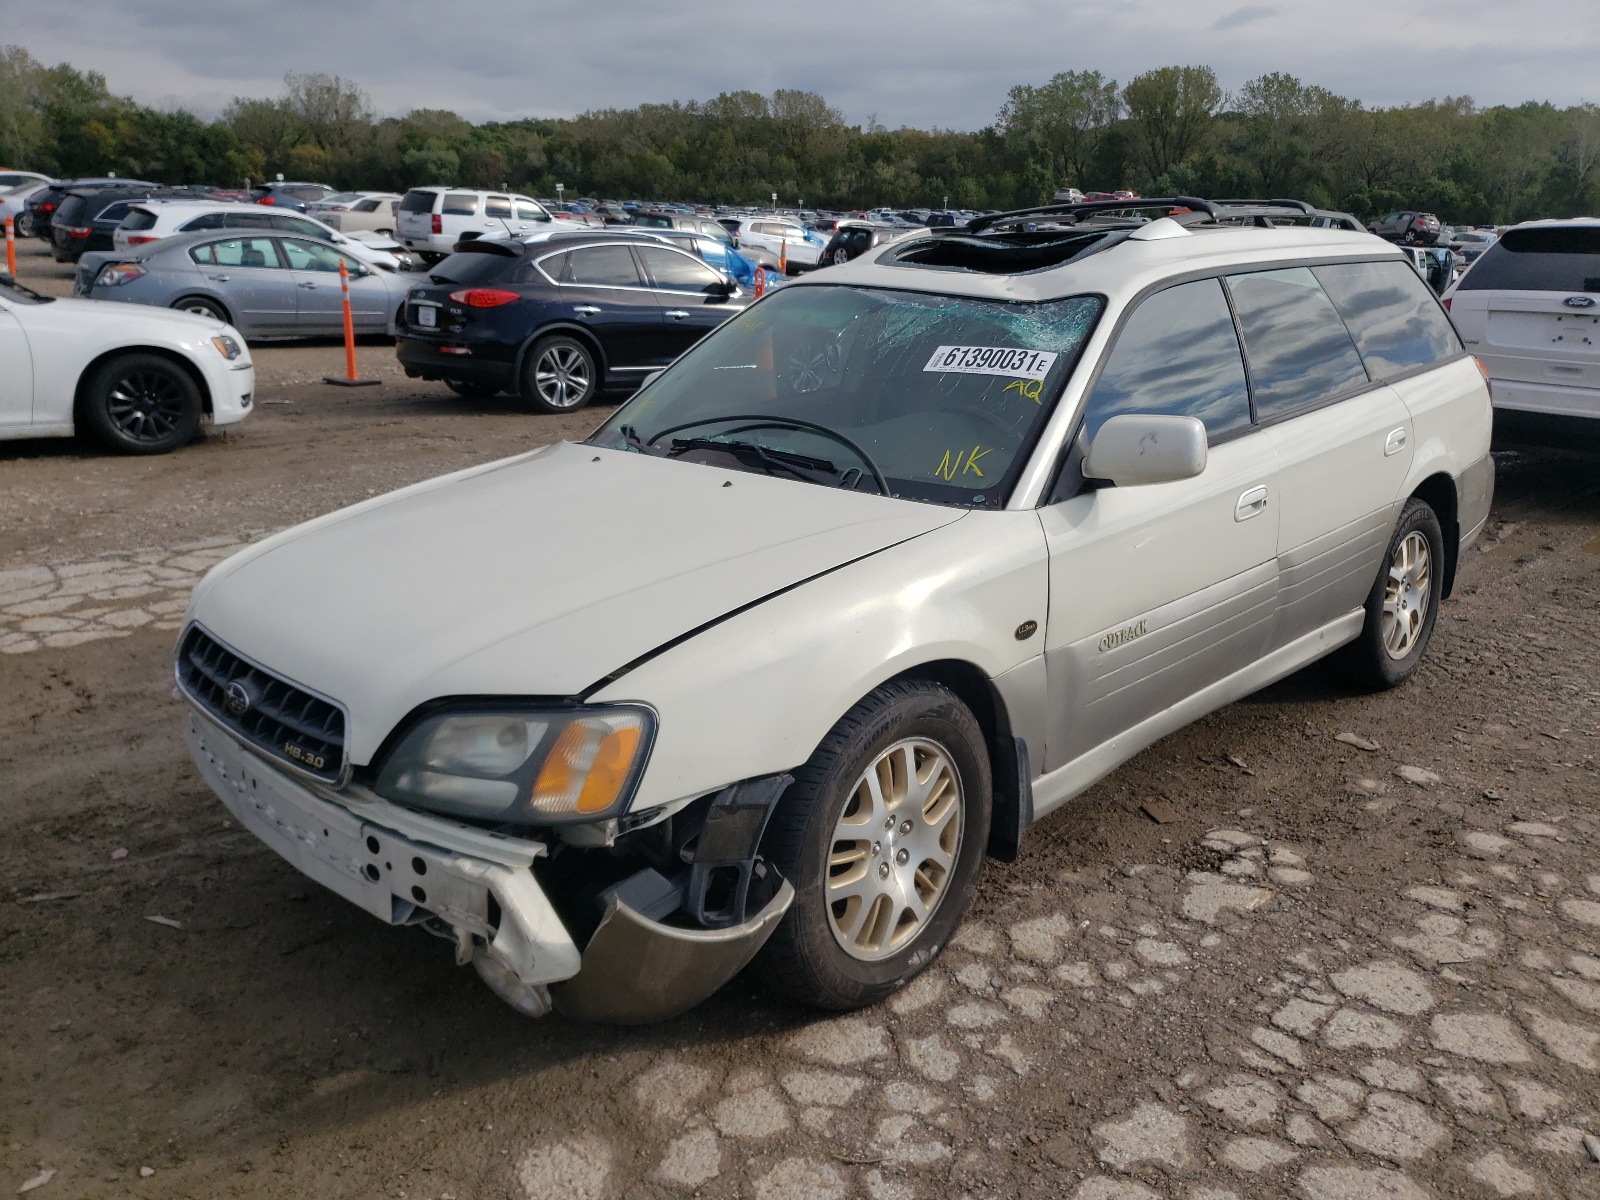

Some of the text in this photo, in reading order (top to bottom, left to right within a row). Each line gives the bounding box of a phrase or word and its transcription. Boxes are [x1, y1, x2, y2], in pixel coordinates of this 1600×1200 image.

[943, 347, 1040, 372] 61390031
[934, 445, 994, 481] NK
[1098, 618, 1147, 652] OUTBACK
